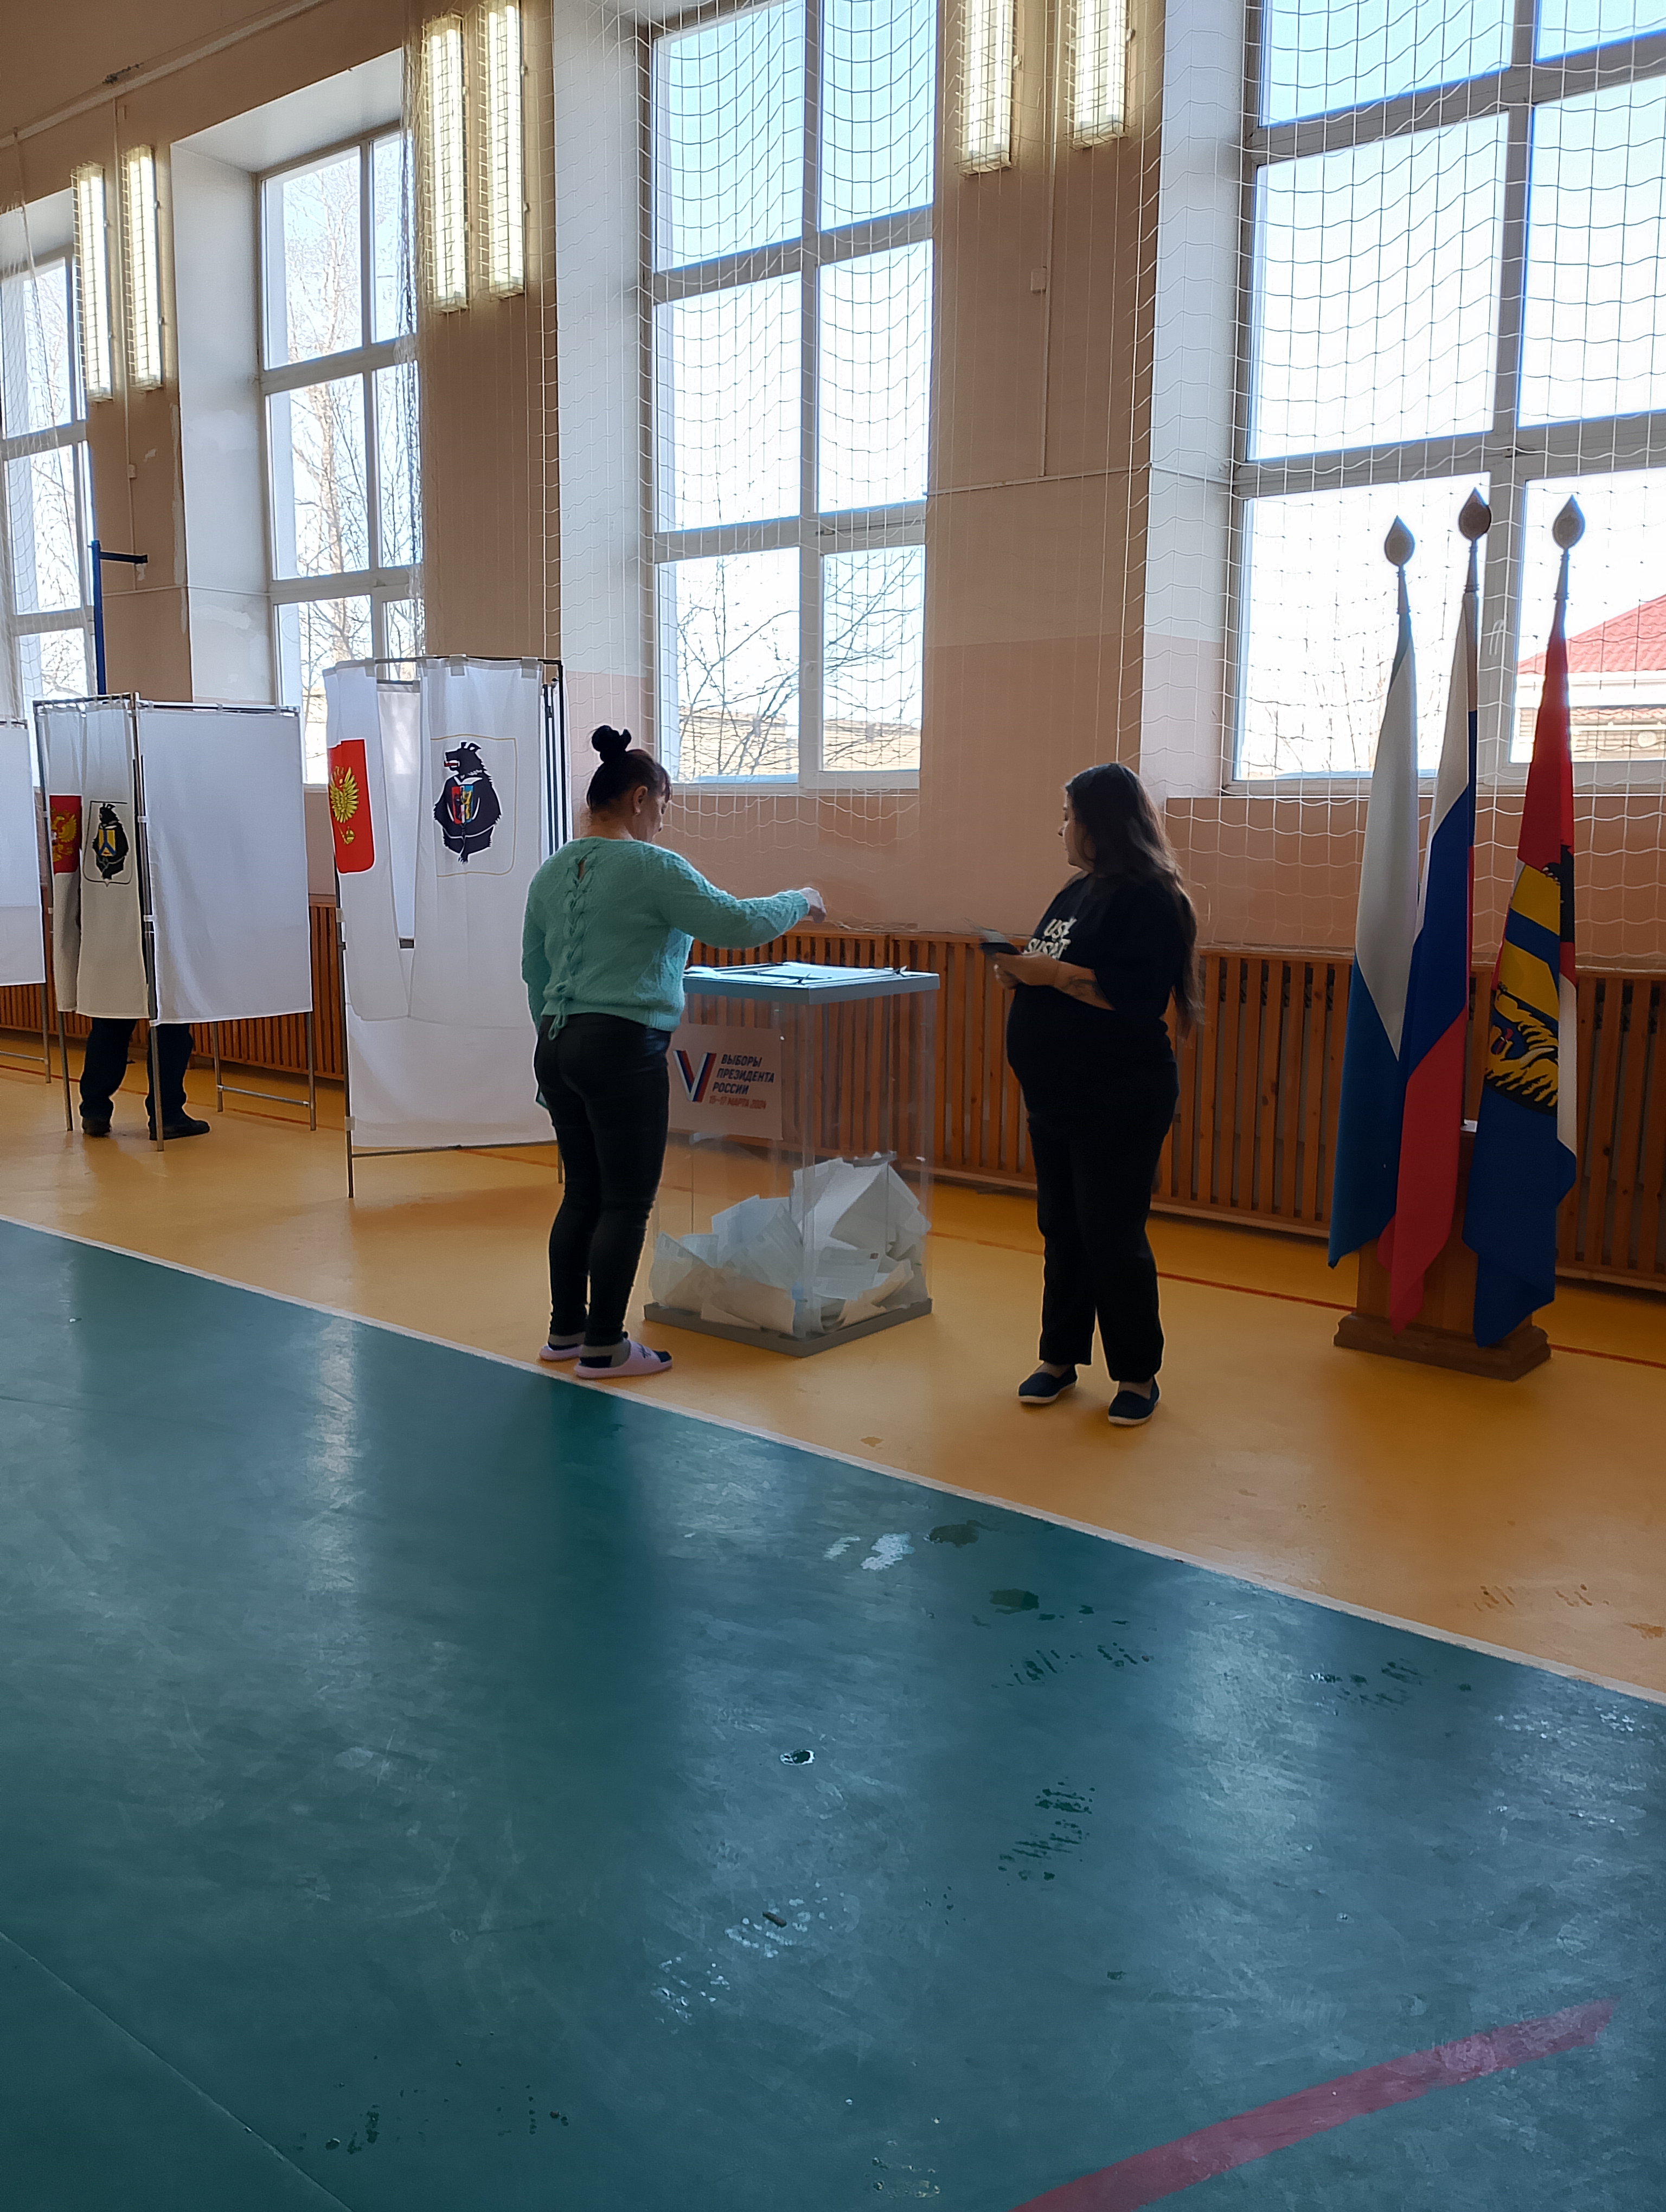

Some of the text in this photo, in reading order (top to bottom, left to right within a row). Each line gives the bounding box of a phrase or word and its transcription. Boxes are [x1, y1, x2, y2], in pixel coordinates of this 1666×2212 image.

[721, 1054, 762, 1068] ВЫБОРЫ
[716, 1068, 775, 1083] ПРЕЗИДЕНТА
[712, 1082, 749, 1095] РОССИИ
